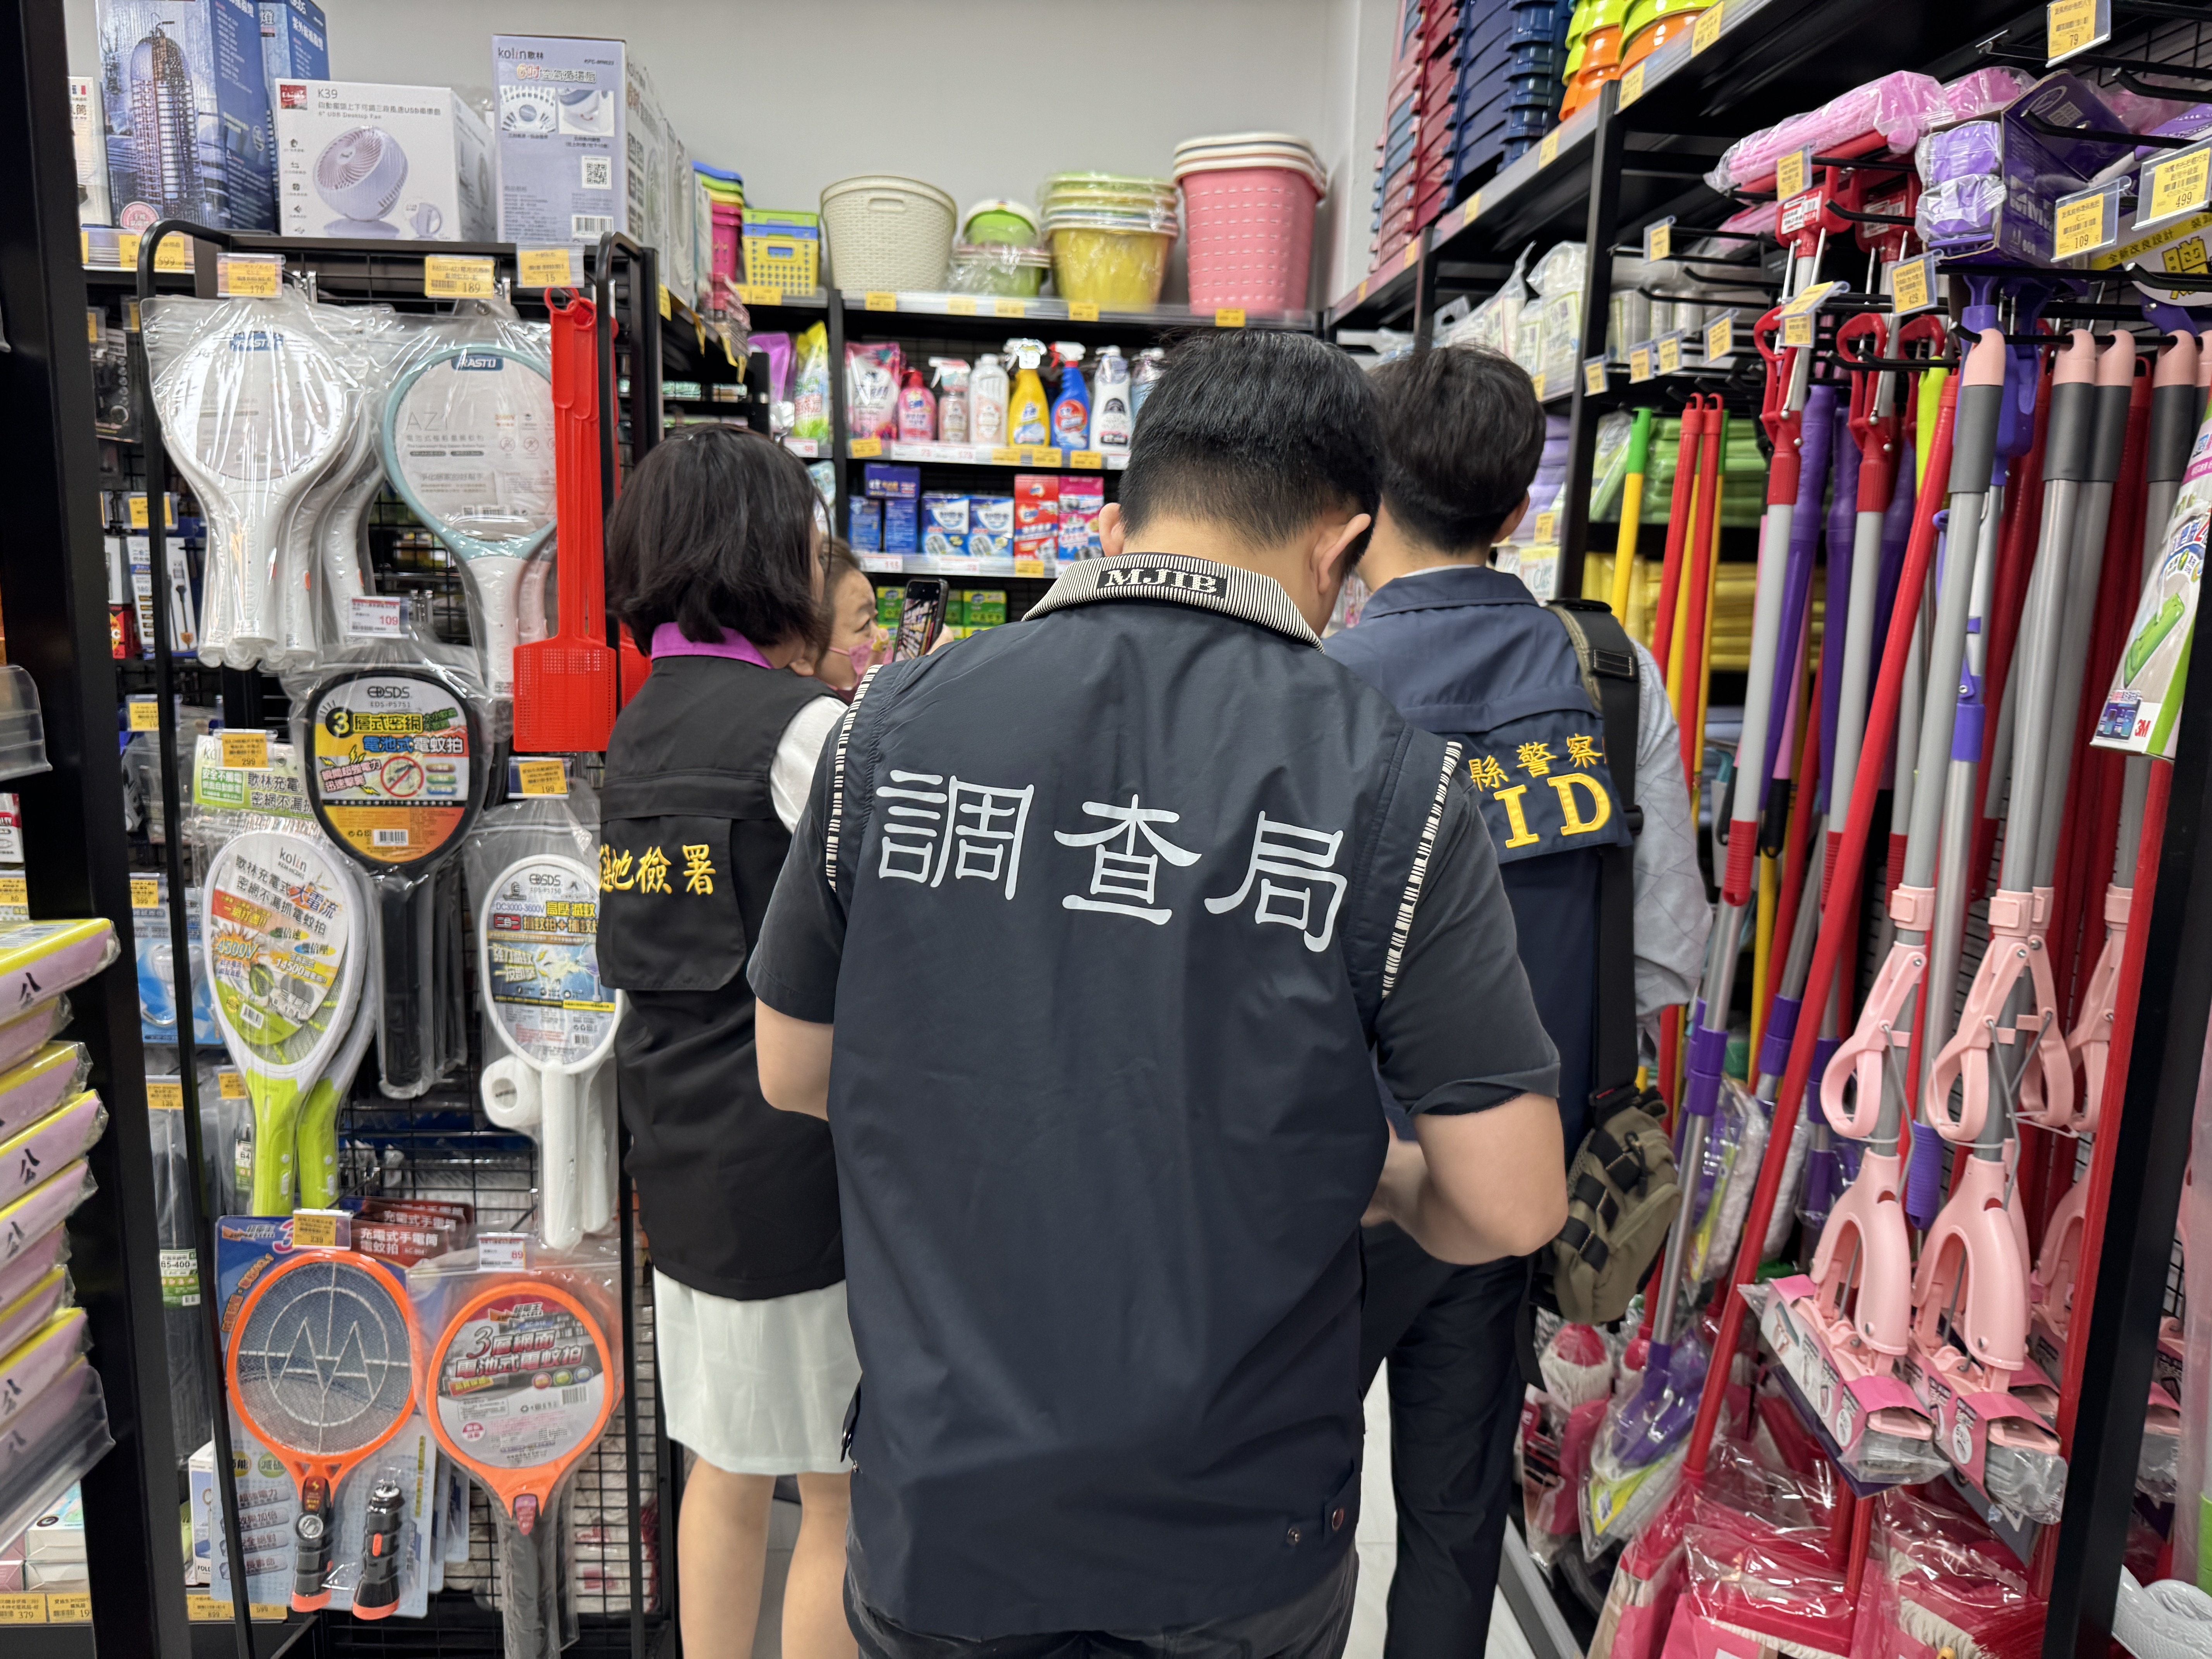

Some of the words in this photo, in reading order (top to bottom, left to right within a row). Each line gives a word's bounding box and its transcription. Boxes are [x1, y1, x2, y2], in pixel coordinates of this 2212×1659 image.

[2070, 34, 2078, 46] 79
[498, 47, 526, 60] kolin
[318, 88, 338, 99] K39
[2175, 192, 2192, 207] 499
[2075, 234, 2088, 249] 109
[462, 282, 481, 294] 189
[406, 411, 448, 431] AZ1
[1104, 568, 1225, 594] MJIB
[380, 615, 398, 626] 109
[2135, 719, 2151, 737] 3M
[363, 735, 464, 754] 電池式電蚊拍
[1468, 733, 1604, 792] 縣警察
[248, 771, 304, 793] 歌林充電
[280, 847, 307, 872] kolin
[876, 769, 1348, 952] 調查局
[217, 939, 260, 959] 4500V
[361, 1227, 438, 1247] 充電式手電筒
[360, 1240, 399, 1255] 電蚊拍
[511, 1250, 523, 1259] 89
[455, 1345, 583, 1378] 電池式電蚊拍
[18, 1611, 34, 1619] 379
